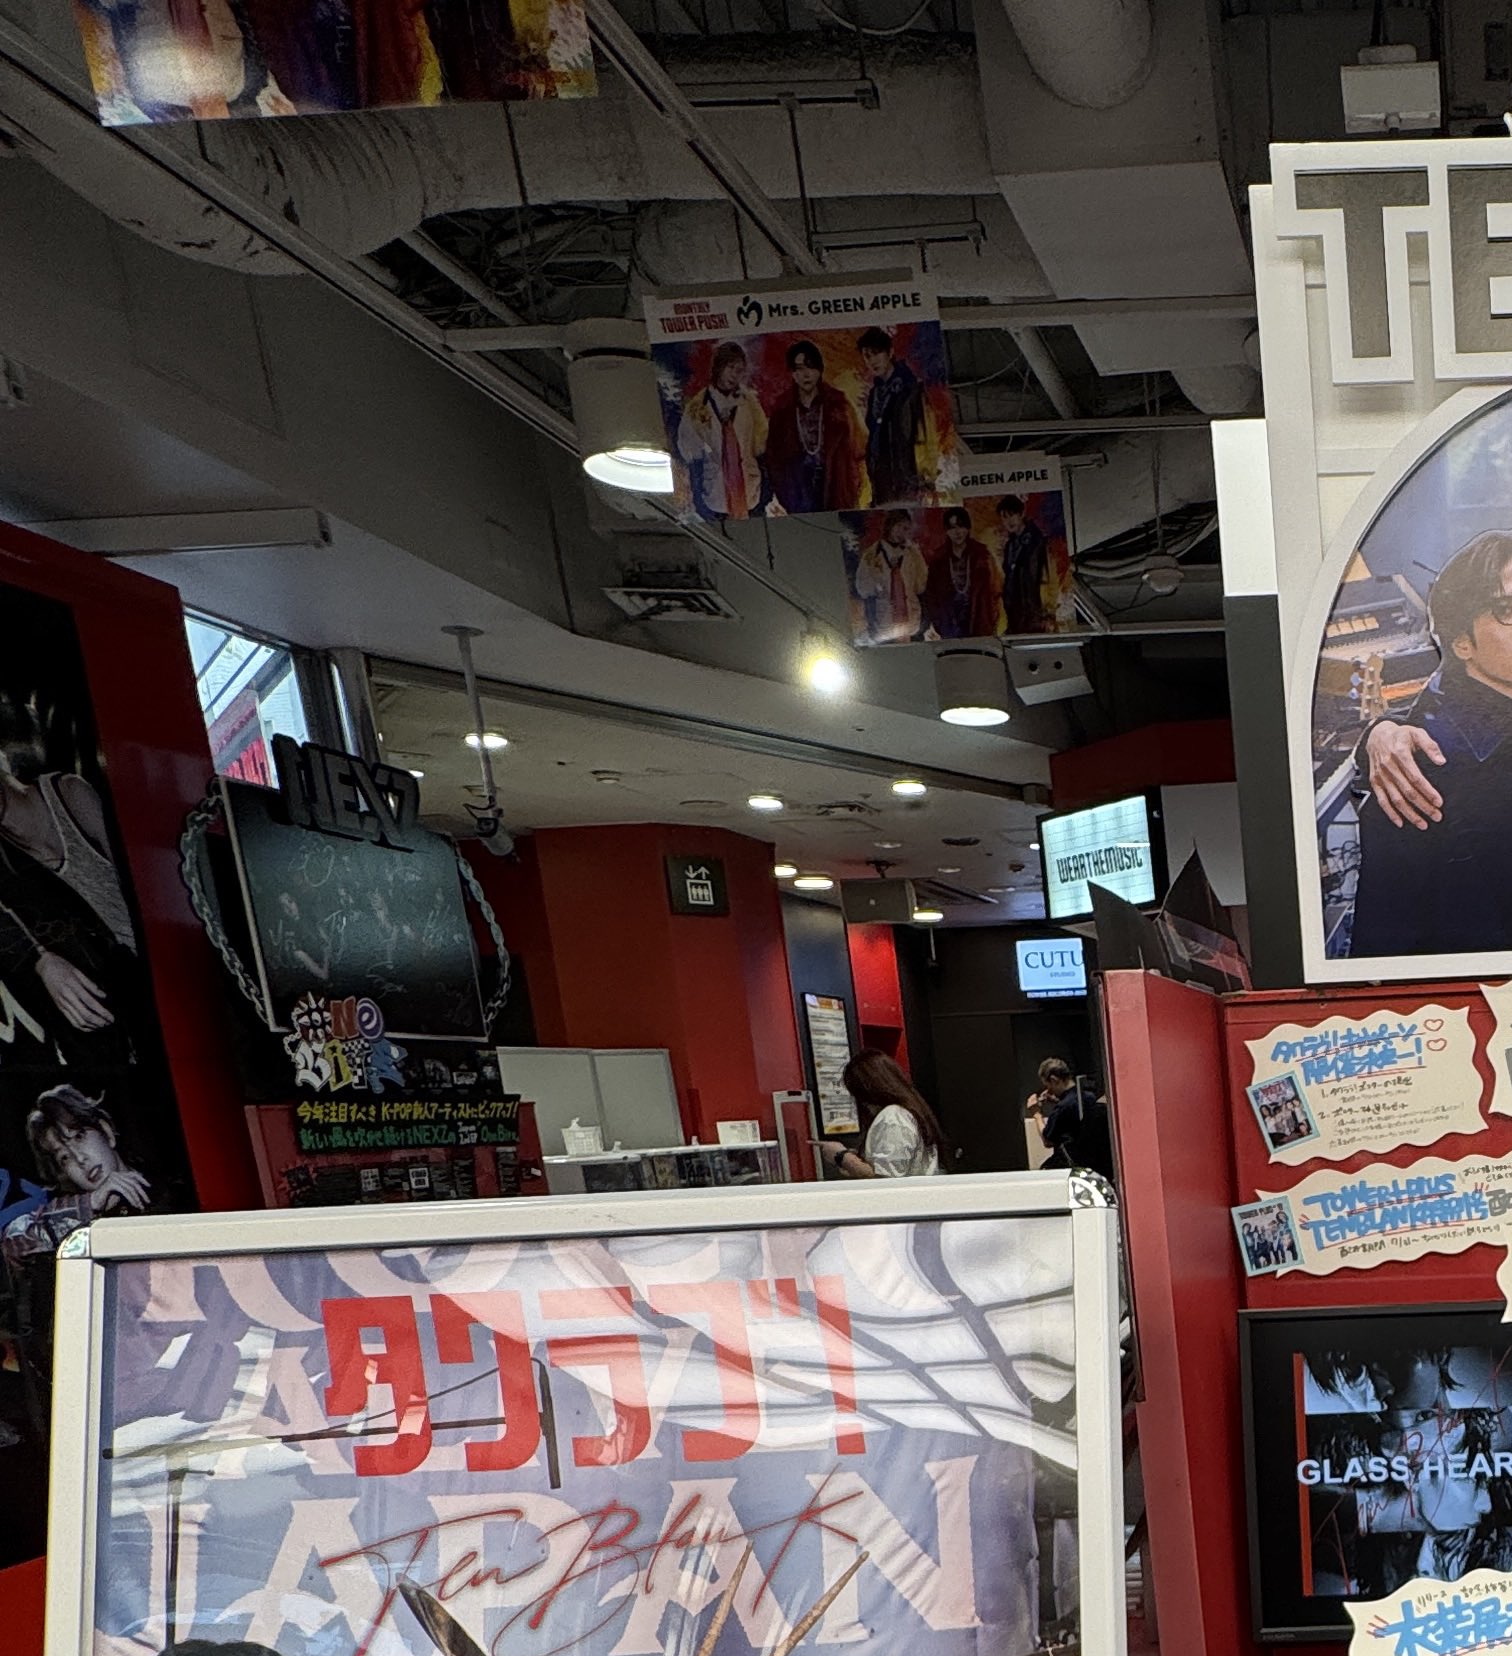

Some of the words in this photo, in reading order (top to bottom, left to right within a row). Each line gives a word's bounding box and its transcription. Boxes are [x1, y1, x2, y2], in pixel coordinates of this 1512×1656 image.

[768, 303, 804, 318] Mrs.
[808, 297, 865, 315] GREEN
[869, 292, 921, 310] APPLE
[659, 315, 695, 334] TOWER
[697, 313, 730, 332] PUSH!
[960, 472, 1005, 487] GREEN
[1007, 469, 1049, 483] APPLE
[322, 1275, 868, 1477] タワラブ!
[1297, 1456, 1412, 1486] GLASS
